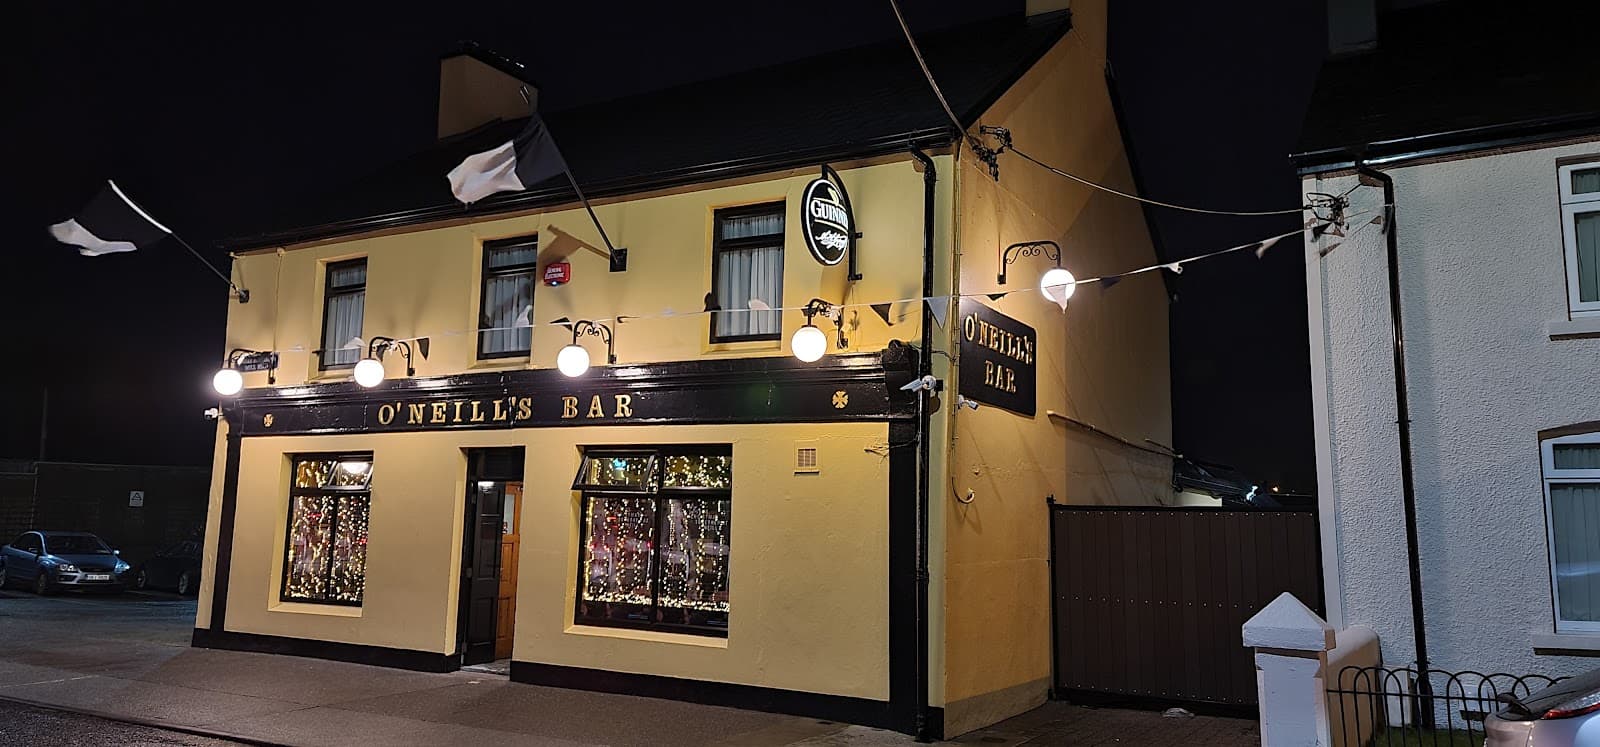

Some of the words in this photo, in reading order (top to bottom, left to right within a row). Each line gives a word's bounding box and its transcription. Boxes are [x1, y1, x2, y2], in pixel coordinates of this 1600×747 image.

[810, 200, 848, 229] GUINN
[965, 313, 1033, 364] O'NEILL'S
[985, 360, 1016, 393] BAR
[378, 396, 532, 425] O'NEILL'S
[561, 394, 633, 419] BAR
